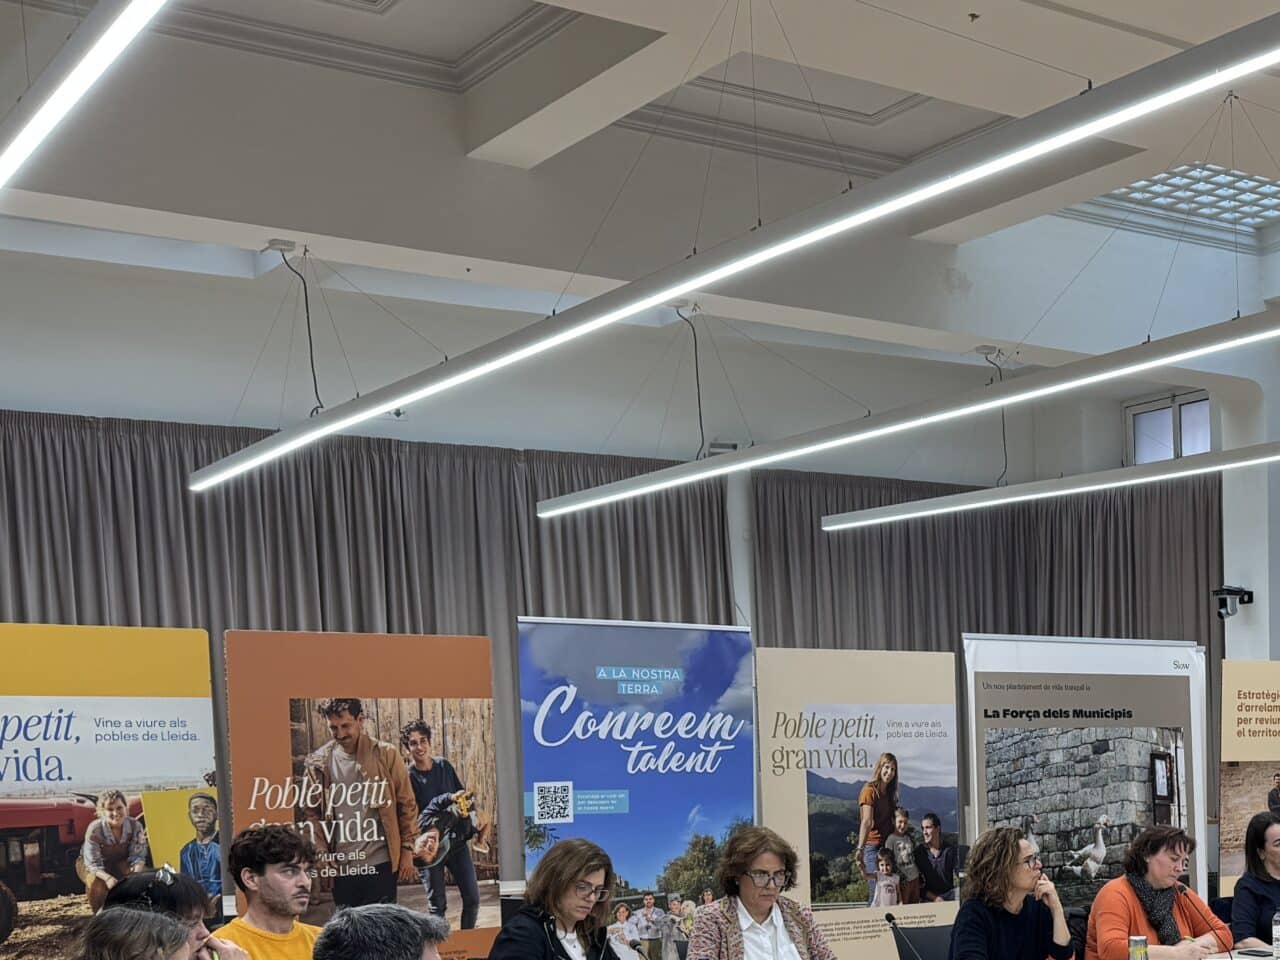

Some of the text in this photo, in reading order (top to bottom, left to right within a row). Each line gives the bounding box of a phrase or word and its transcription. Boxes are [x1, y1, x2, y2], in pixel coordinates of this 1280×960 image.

[597, 668, 680, 681] A LA NOSTRA
[621, 684, 659, 695] TERRA
[533, 684, 745, 747] Conreem
[984, 708, 1133, 721] La Força dels Municipis
[1237, 716, 1252, 727] per
[0, 708, 81, 750] petit,
[93, 717, 187, 728] Vine a viure als
[771, 711, 879, 745] Poble petit,
[95, 730, 200, 744] pobles de Lleida.
[1237, 728, 1245, 738] el
[620, 740, 736, 774] talent
[771, 742, 873, 777] gran vida.
[248, 775, 392, 815] Poble petit,
[320, 811, 385, 844] vida.
[348, 849, 366, 861] als
[320, 866, 337, 878] de
[339, 864, 379, 877] Lleida.
